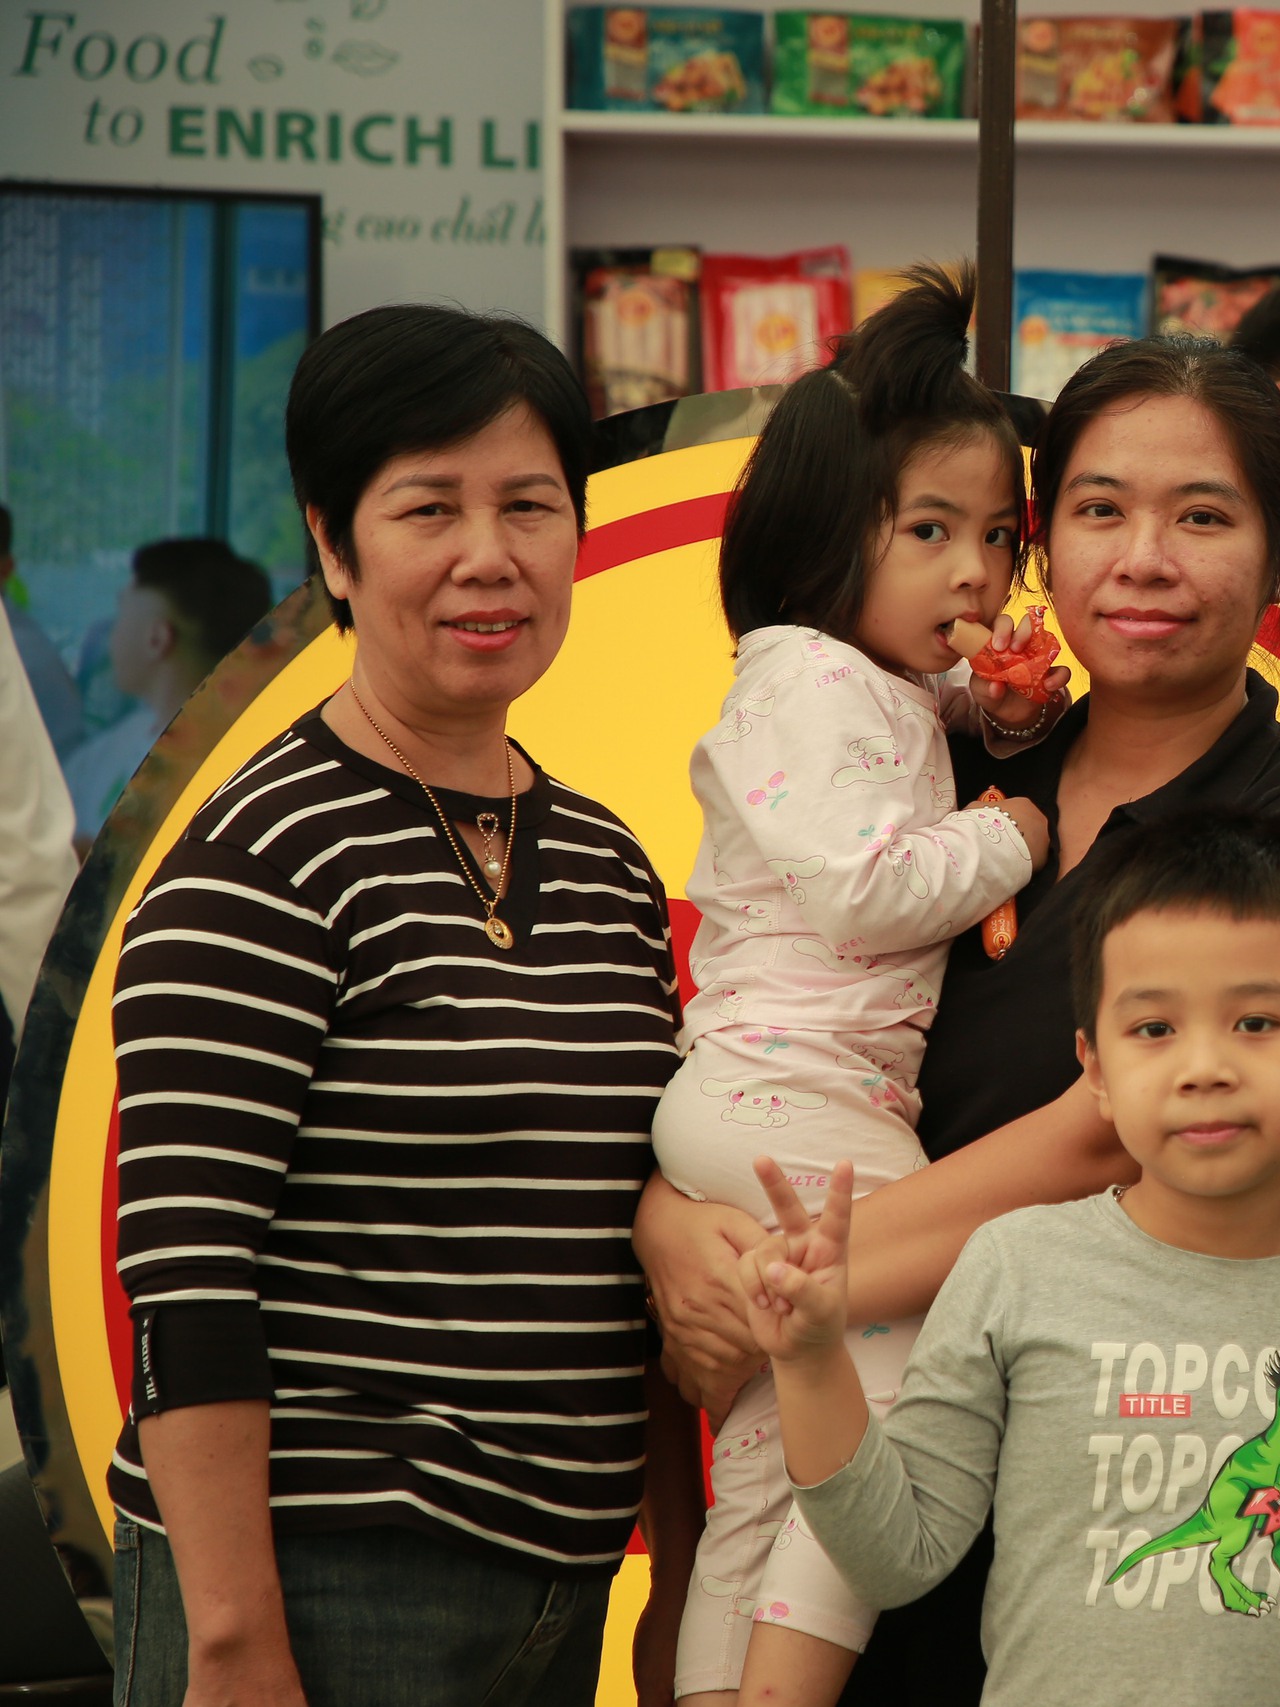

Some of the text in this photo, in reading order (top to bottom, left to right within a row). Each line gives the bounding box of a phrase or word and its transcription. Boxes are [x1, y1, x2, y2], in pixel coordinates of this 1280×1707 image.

[10, 10, 226, 84] Food
[84, 97, 144, 146] to
[168, 105, 453, 168] ENRICH
[814, 666, 857, 689] UTE!
[784, 1174, 828, 1188] UTE
[1125, 1396, 1187, 1415] TITLE
